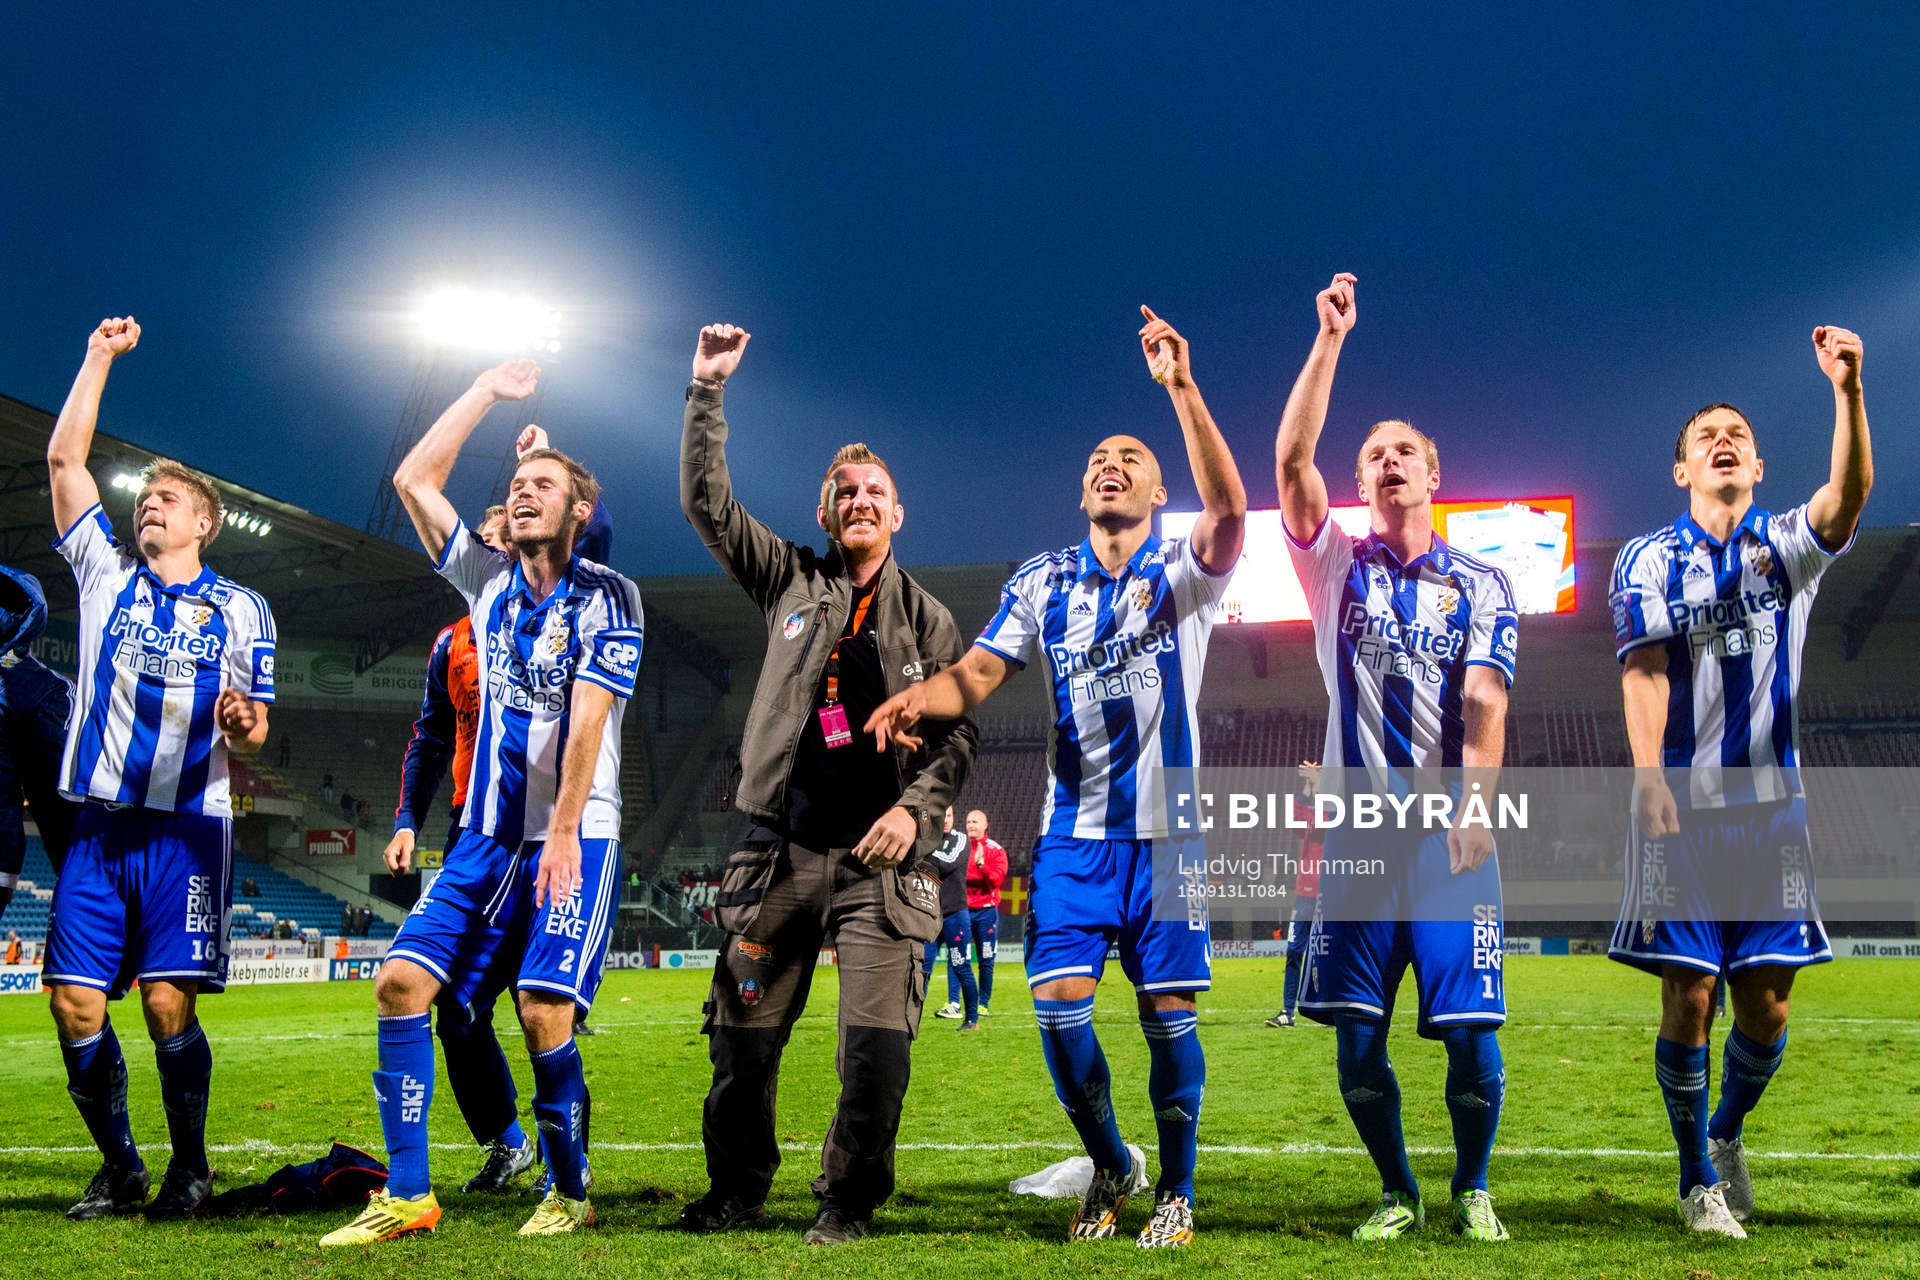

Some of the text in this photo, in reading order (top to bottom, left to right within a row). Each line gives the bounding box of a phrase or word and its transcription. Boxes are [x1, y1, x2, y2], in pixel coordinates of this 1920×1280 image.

[1668, 579, 1786, 632] Prioritet
[111, 609, 220, 661] Prioritet
[1343, 603, 1462, 660] Prioritet
[1688, 624, 1776, 659] Finans
[115, 641, 197, 678] Finans
[602, 641, 638, 666] GP
[1053, 622, 1174, 676] Prioritet
[597, 656, 635, 679] Batteries
[1355, 640, 1442, 684] Finans
[276, 672, 304, 684] GEN
[372, 677, 426, 689] BRIGGE
[1071, 667, 1160, 703] Finans
[489, 672, 564, 712] Finans
[188, 875, 211, 895] SE
[187, 895, 212, 914] RN
[1473, 904, 1498, 926] SE
[185, 914, 218, 933] EKE
[545, 913, 583, 941] EKE
[1213, 941, 1255, 951] OFFICE
[1473, 926, 1499, 948] RN
[191, 939, 217, 962] 16
[558, 949, 576, 973] 2
[1213, 950, 1287, 958] MANAGEMEN
[1852, 943, 1920, 956] Allt om H
[0, 973, 39, 991] SPORT
[110, 1069, 128, 1115] SKF
[402, 1075, 425, 1123] SKF
[570, 1101, 584, 1142] SKF
